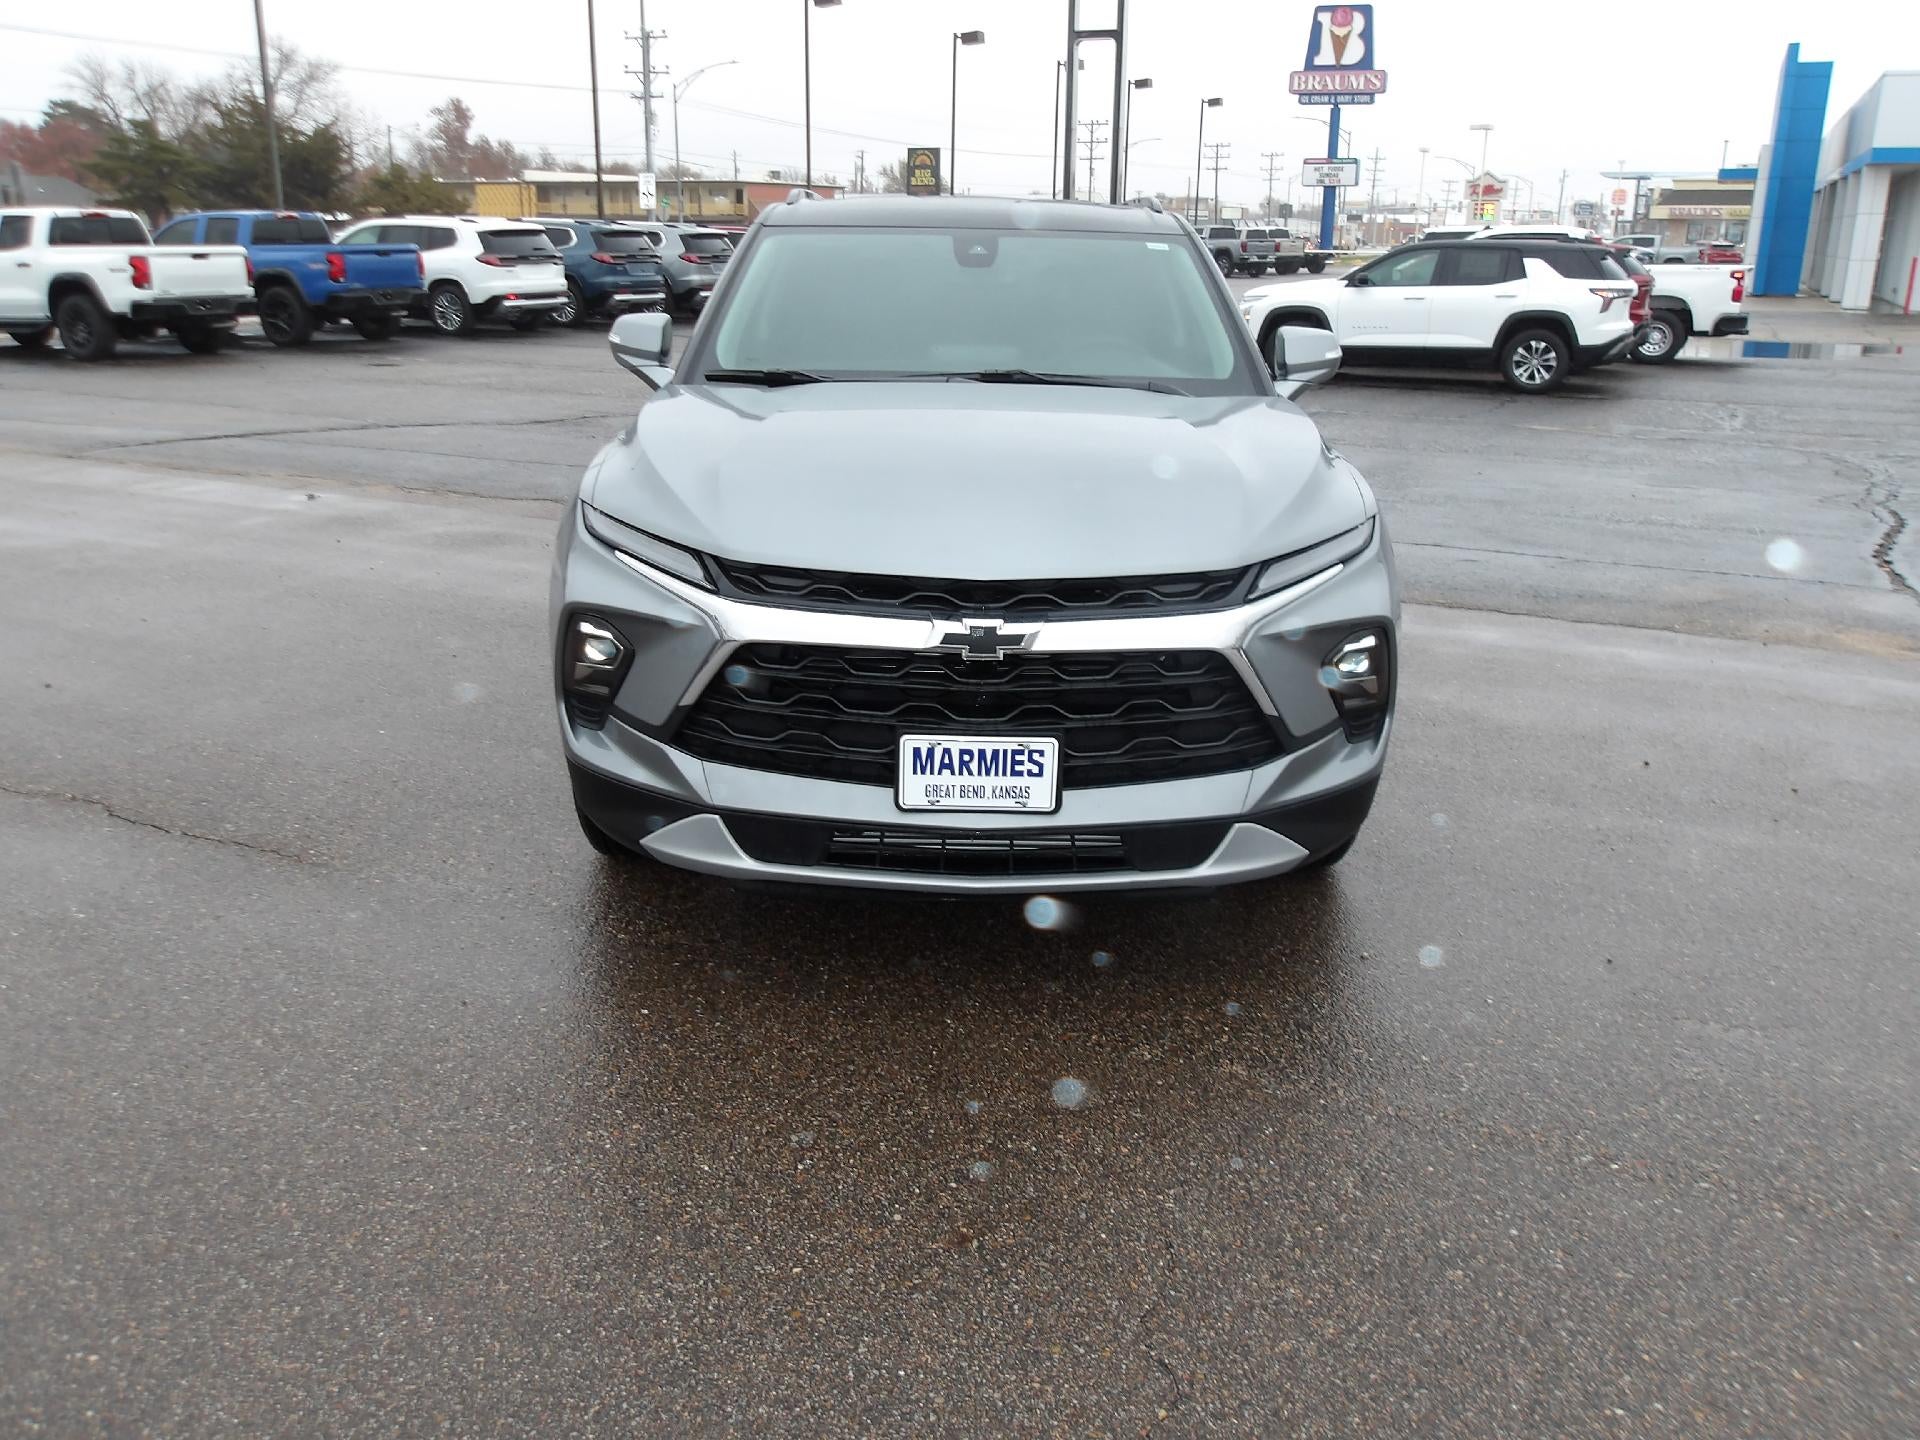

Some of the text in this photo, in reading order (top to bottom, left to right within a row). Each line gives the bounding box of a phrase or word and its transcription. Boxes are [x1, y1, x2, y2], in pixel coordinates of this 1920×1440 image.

[1292, 73, 1382, 91] BRAUM'S
[1310, 95, 1329, 103] CREAM
[911, 176, 936, 186] BEND
[912, 747, 1045, 778] MARMIES
[925, 784, 956, 799] GREAT
[991, 785, 1031, 800] KANSAS
